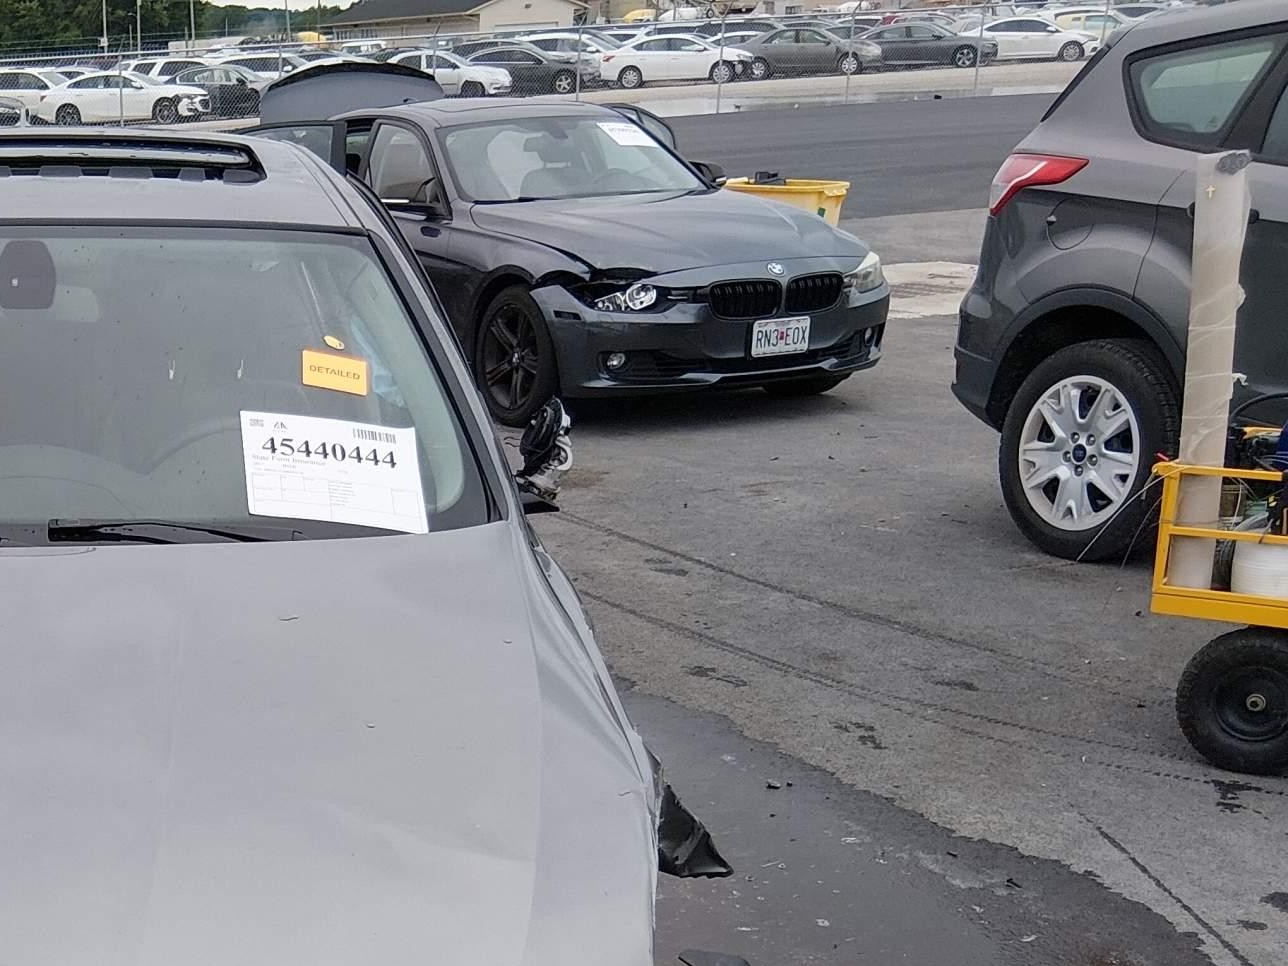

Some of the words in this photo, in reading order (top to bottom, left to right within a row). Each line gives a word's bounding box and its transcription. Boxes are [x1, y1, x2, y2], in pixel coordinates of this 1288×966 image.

[755, 329, 779, 348] RN3
[309, 364, 361, 380] DETAILED
[262, 436, 397, 469] 45440444
